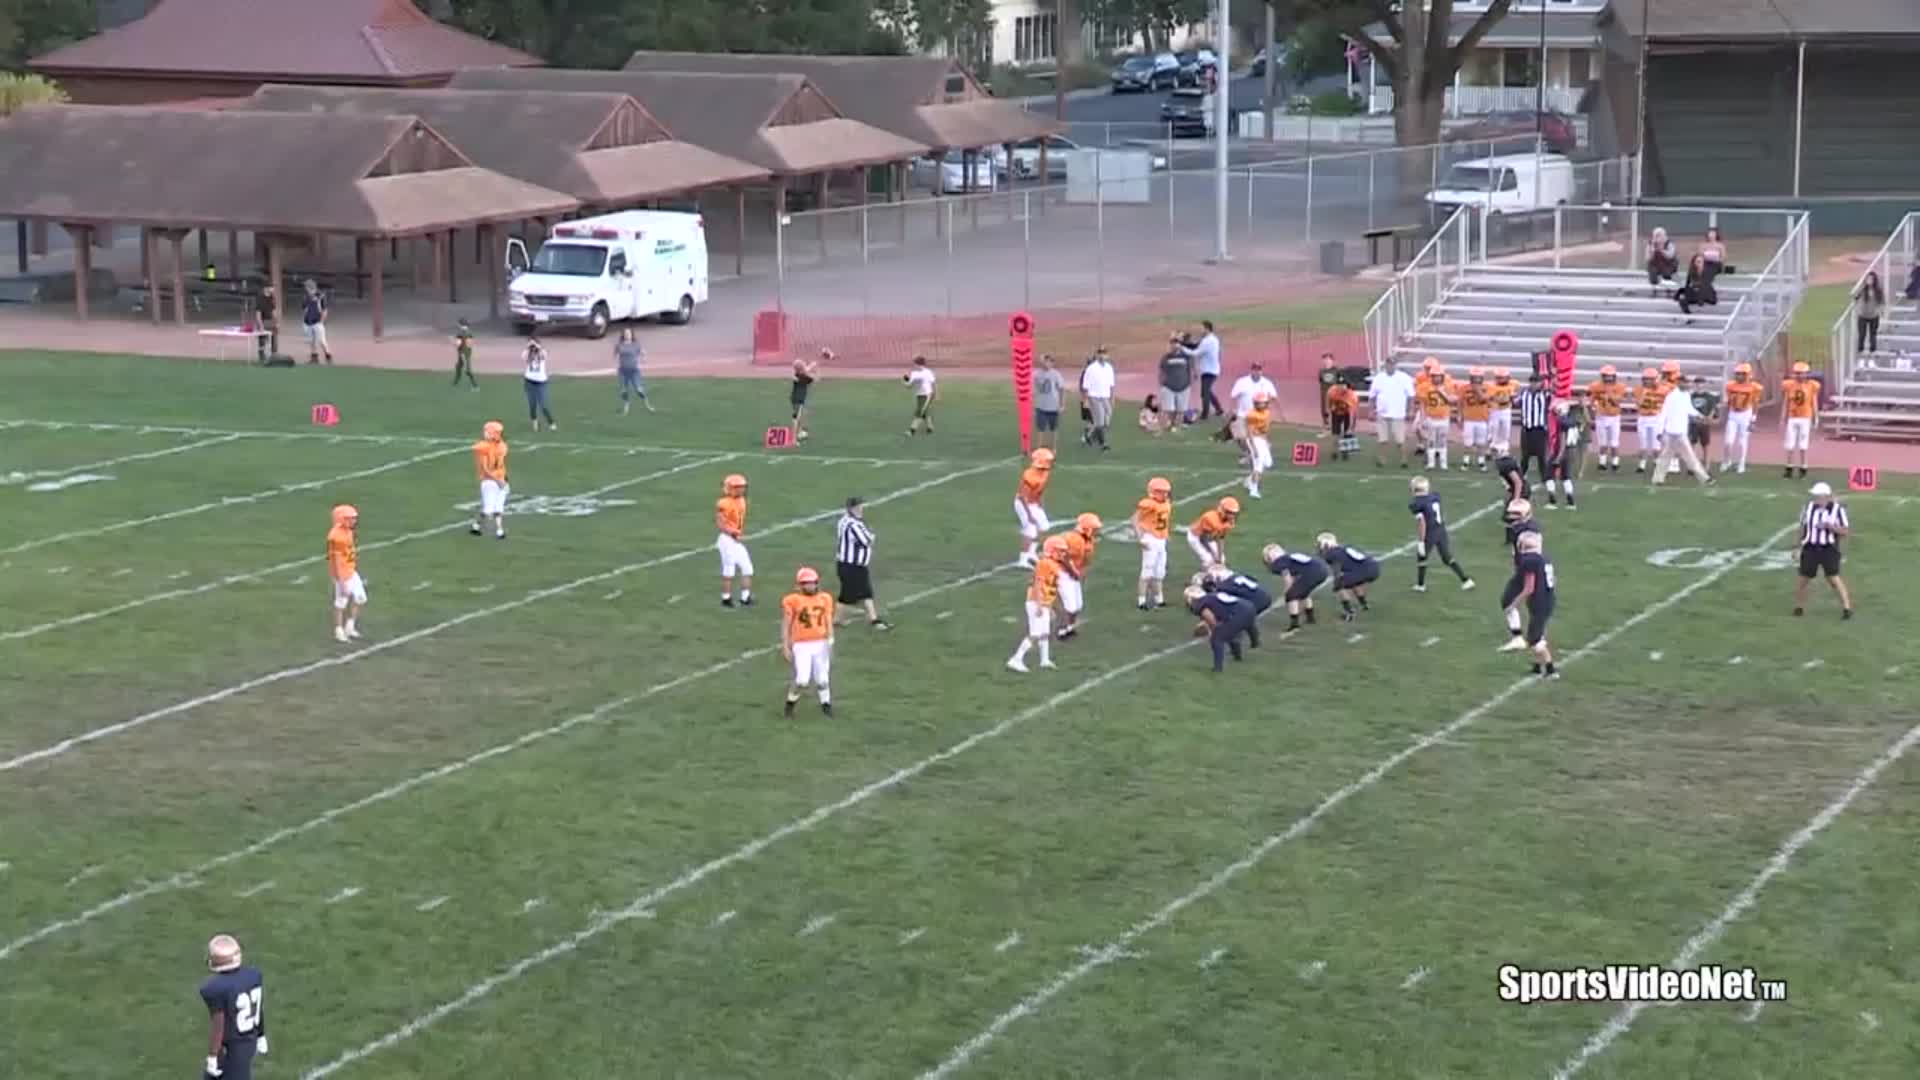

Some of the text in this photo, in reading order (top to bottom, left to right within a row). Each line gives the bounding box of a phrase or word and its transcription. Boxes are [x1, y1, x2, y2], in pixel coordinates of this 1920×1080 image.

[768, 429, 786, 446] 20
[1295, 444, 1315, 462] 30
[1852, 468, 1873, 486] 40
[798, 606, 826, 629] 47
[235, 986, 263, 1033] 27
